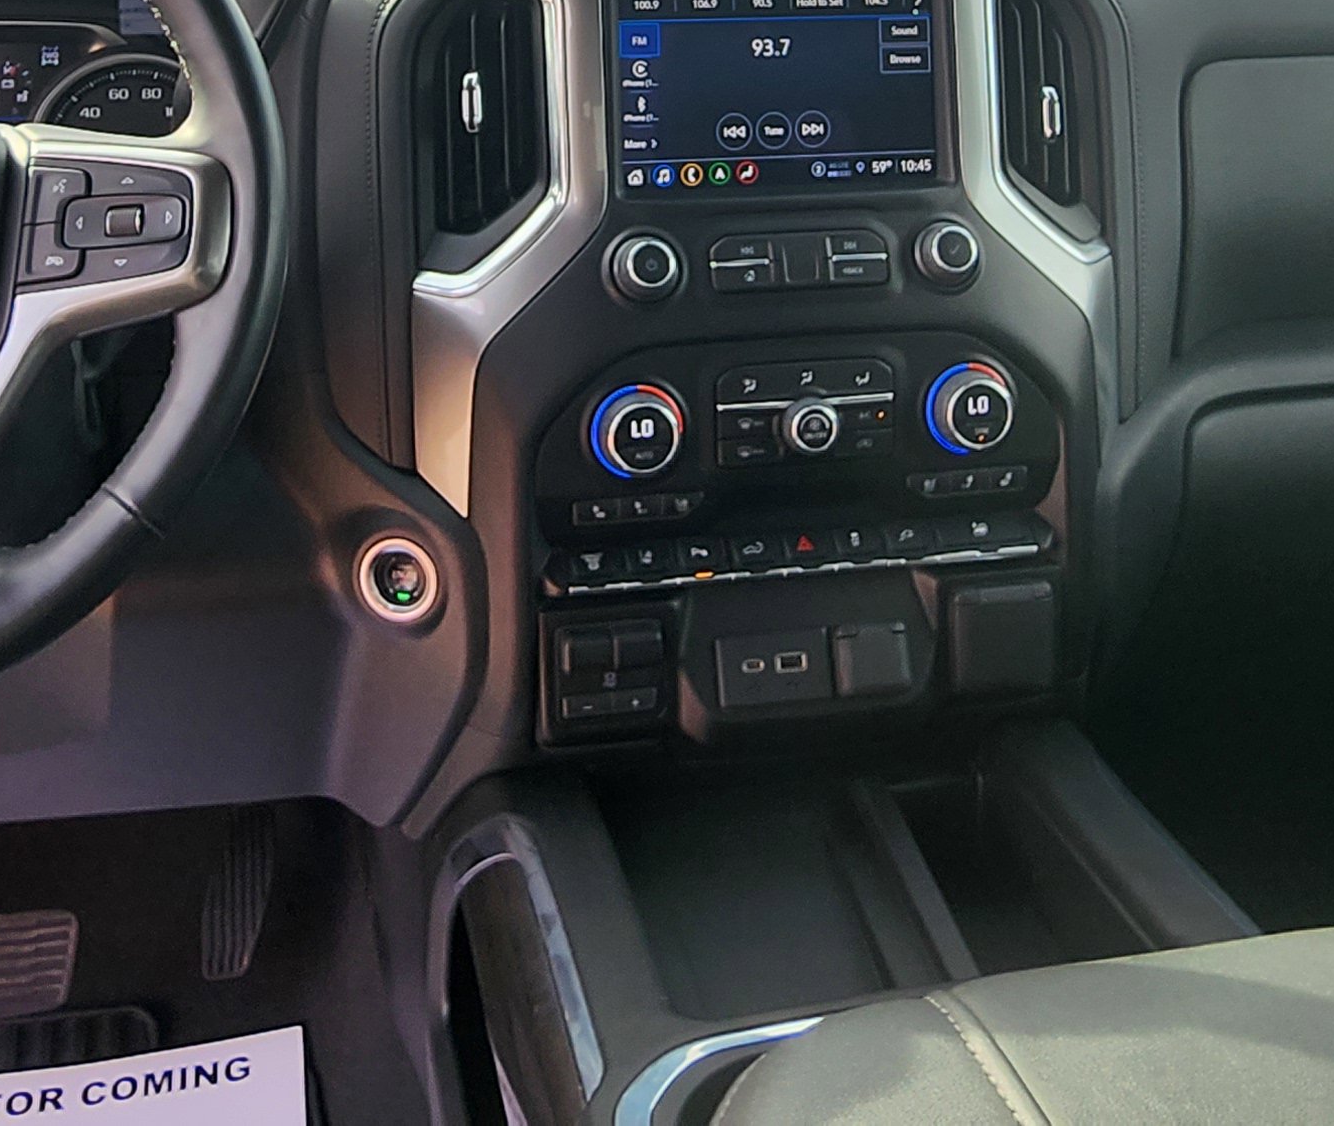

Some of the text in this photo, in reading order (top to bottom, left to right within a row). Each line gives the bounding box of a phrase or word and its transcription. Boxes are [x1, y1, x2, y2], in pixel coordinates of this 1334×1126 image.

[634, 0, 659, 10] 100.9
[692, 0, 718, 9] 106.9
[891, 25, 918, 36] Sound
[632, 36, 647, 46] FM
[751, 39, 791, 57] 93.7
[889, 55, 921, 64] Browse
[108, 88, 162, 100] 60 80
[79, 107, 101, 118] 40
[872, 160, 893, 174] 59°
[901, 159, 931, 173] 10:45
[967, 395, 990, 415] LO
[630, 418, 655, 439] LO
[81, 1056, 251, 1107] COMING
